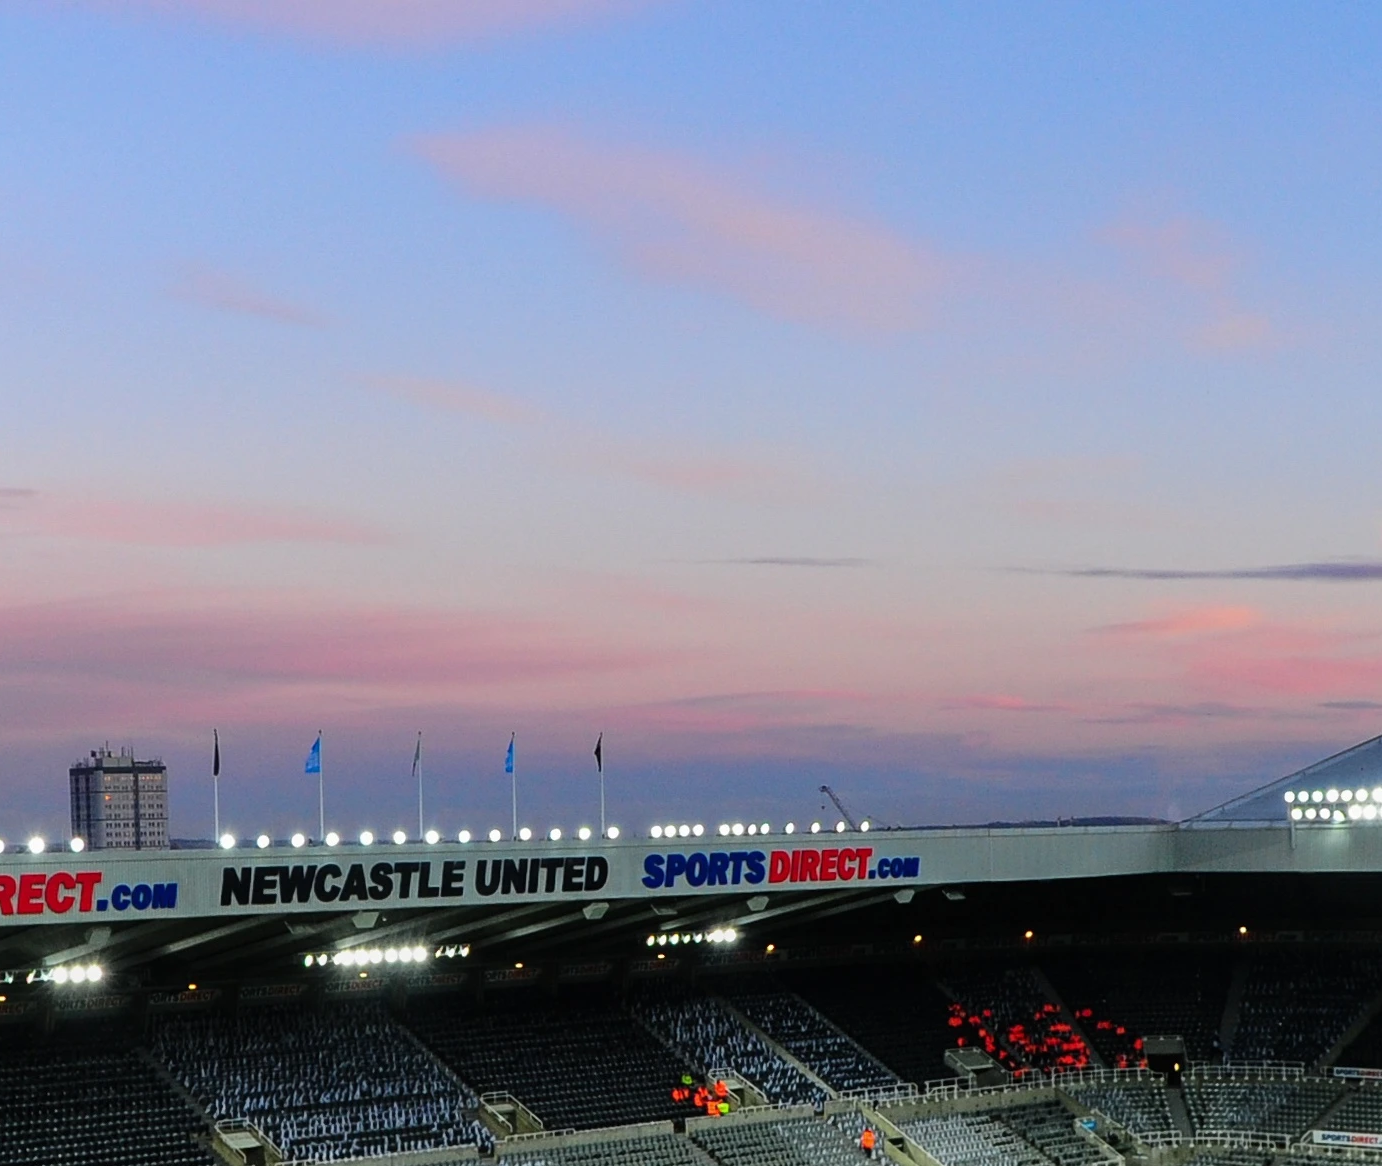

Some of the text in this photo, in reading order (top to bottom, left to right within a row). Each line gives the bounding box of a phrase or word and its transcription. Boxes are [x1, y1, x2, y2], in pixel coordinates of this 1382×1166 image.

[220, 856, 609, 906] NEWCASTLE UNITED
[642, 848, 920, 889] SPORTSDIRECT.COM
